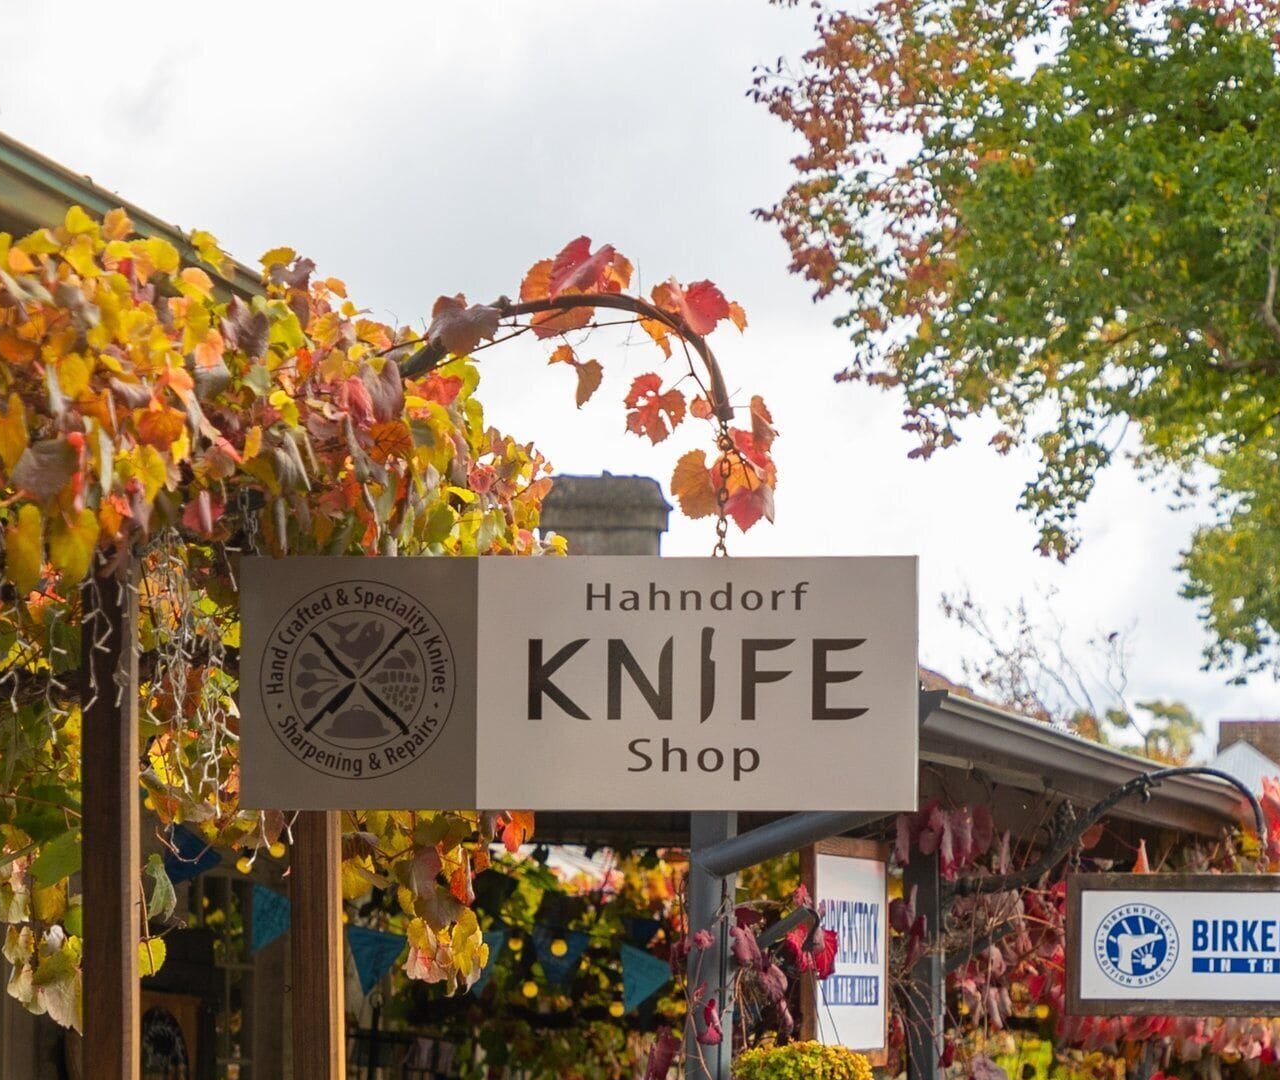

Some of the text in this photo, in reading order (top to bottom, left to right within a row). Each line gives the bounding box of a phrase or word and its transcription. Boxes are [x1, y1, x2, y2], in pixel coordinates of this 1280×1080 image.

[585, 581, 810, 611] Hahndorf
[265, 586, 449, 695] Hand Crafted & Speciality Knives
[527, 625, 870, 724] KNIFE
[277, 714, 438, 777] Sharpening & Repairs
[627, 737, 761, 781] Shop
[1102, 906, 1171, 931] BIRKENSTOCK
[1097, 938, 1133, 984] TRADITION
[1138, 966, 1167, 985] SINCE
[1208, 958, 1231, 973] IN
